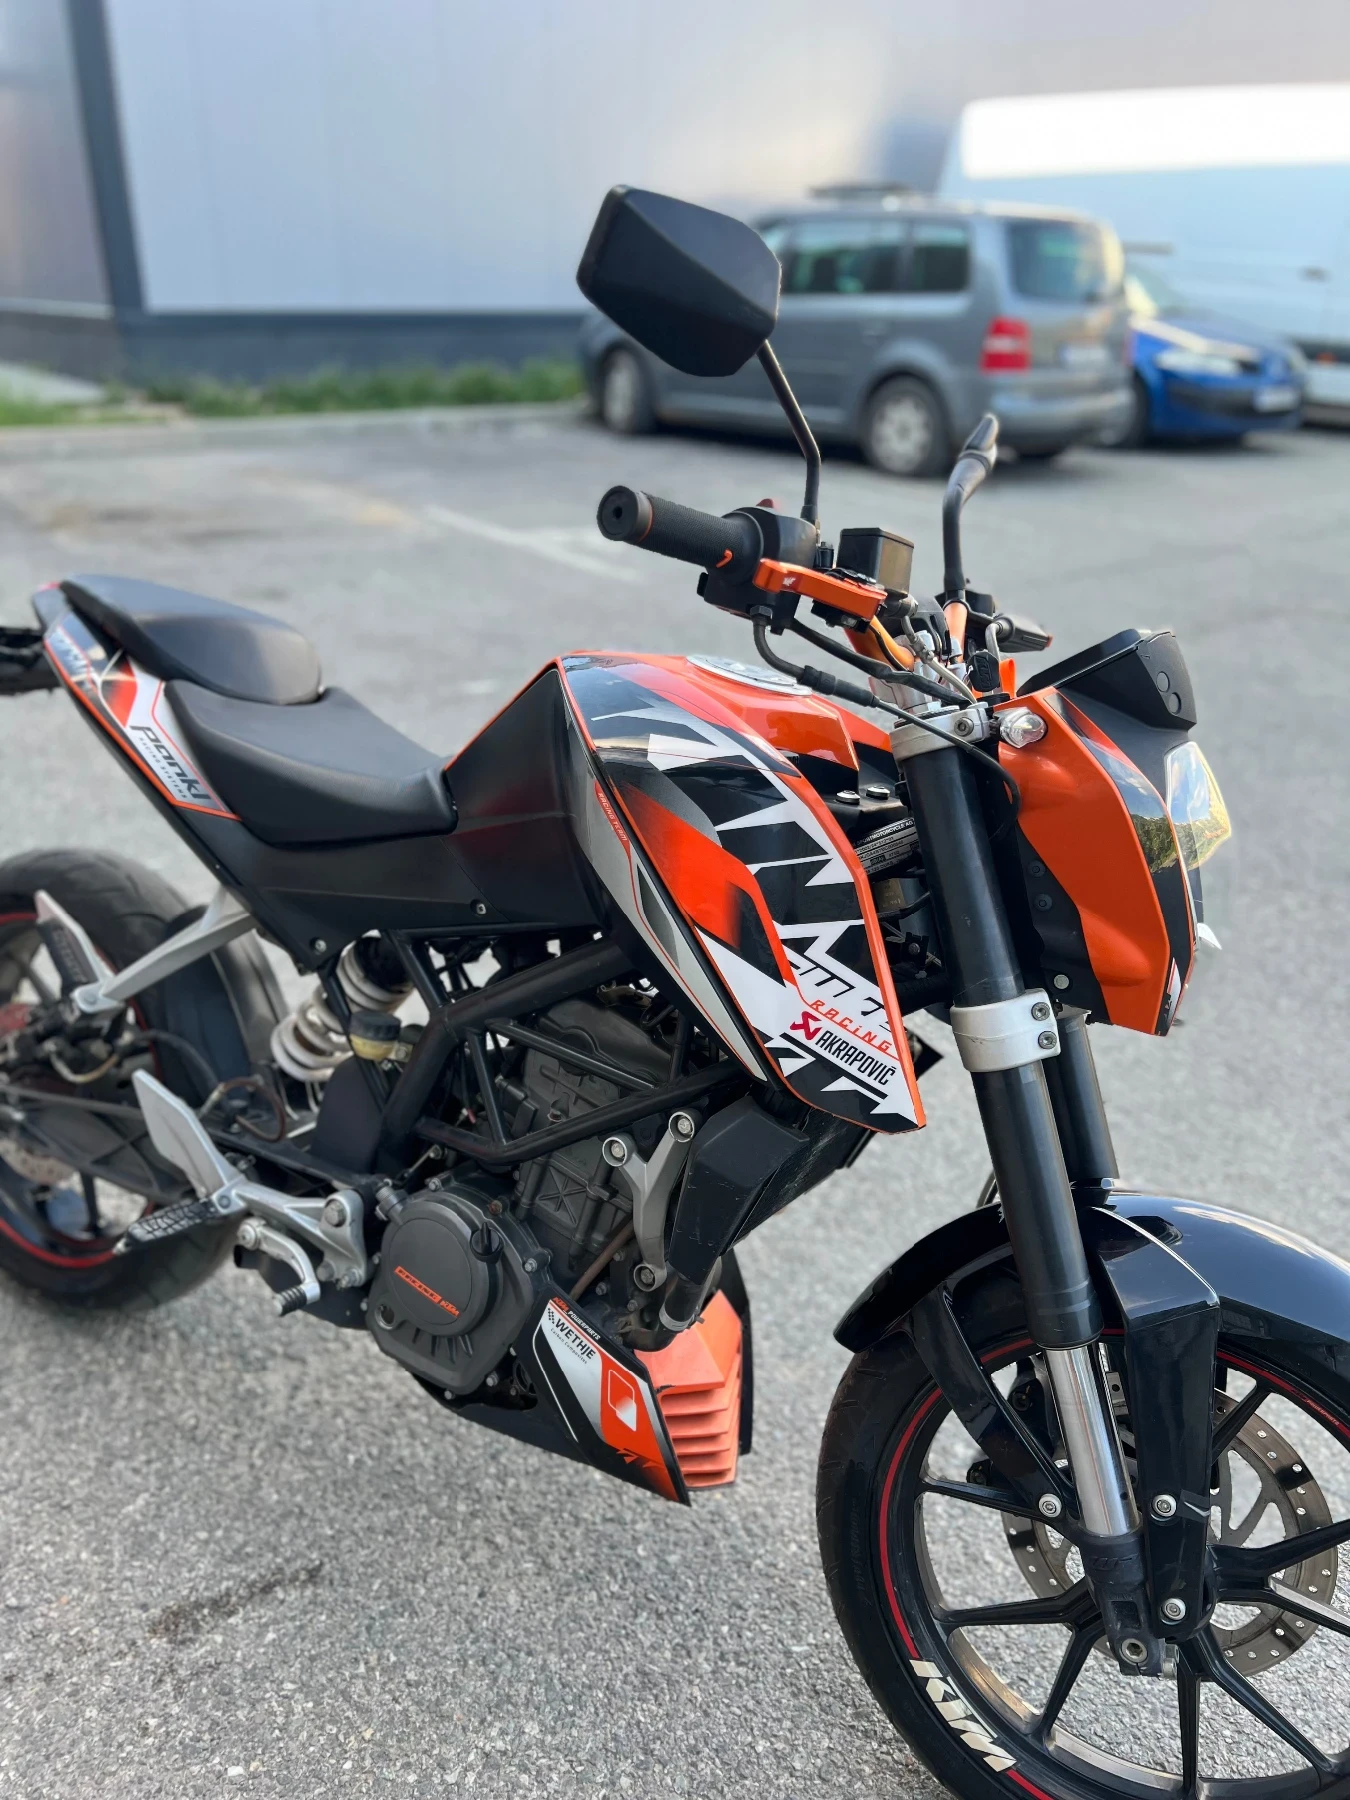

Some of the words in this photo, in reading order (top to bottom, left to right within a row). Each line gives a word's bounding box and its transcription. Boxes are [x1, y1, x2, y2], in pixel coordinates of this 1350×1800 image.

[815, 1030, 897, 1086] AKRAPOVIČ
[555, 1318, 597, 1360] WETHJE
[568, 1310, 601, 1341] POWERPARTS
[909, 1659, 1017, 1773] KTM
